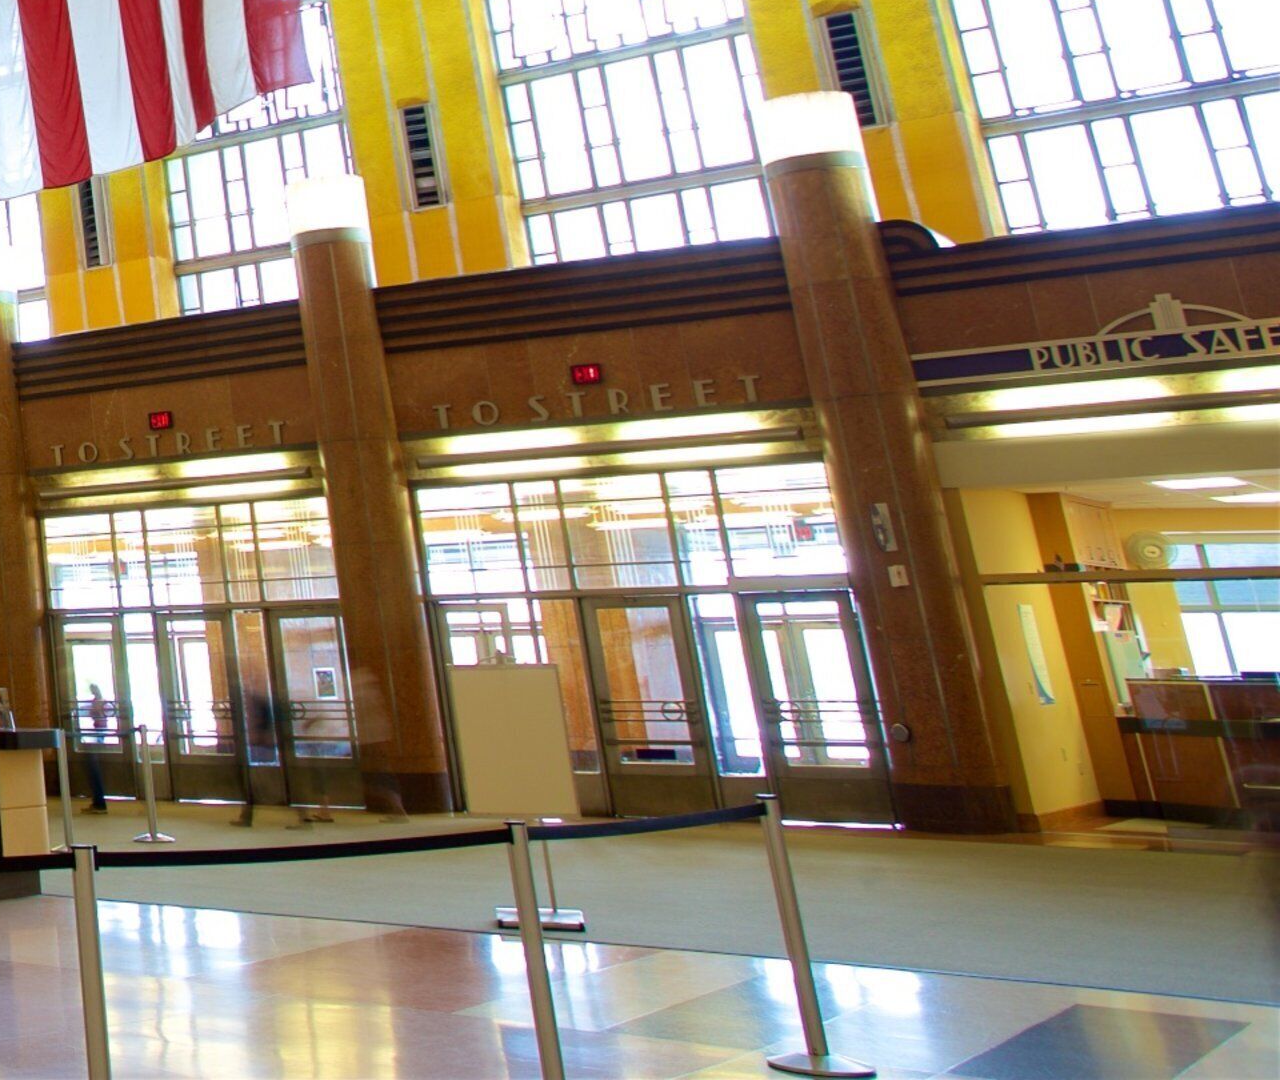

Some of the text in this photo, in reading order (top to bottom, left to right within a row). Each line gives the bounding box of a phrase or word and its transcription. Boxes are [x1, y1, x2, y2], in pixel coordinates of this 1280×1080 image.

[1028, 336, 1160, 371] PUBLIC
[432, 375, 760, 430] TO STREET
[50, 420, 286, 467] TO STREET
